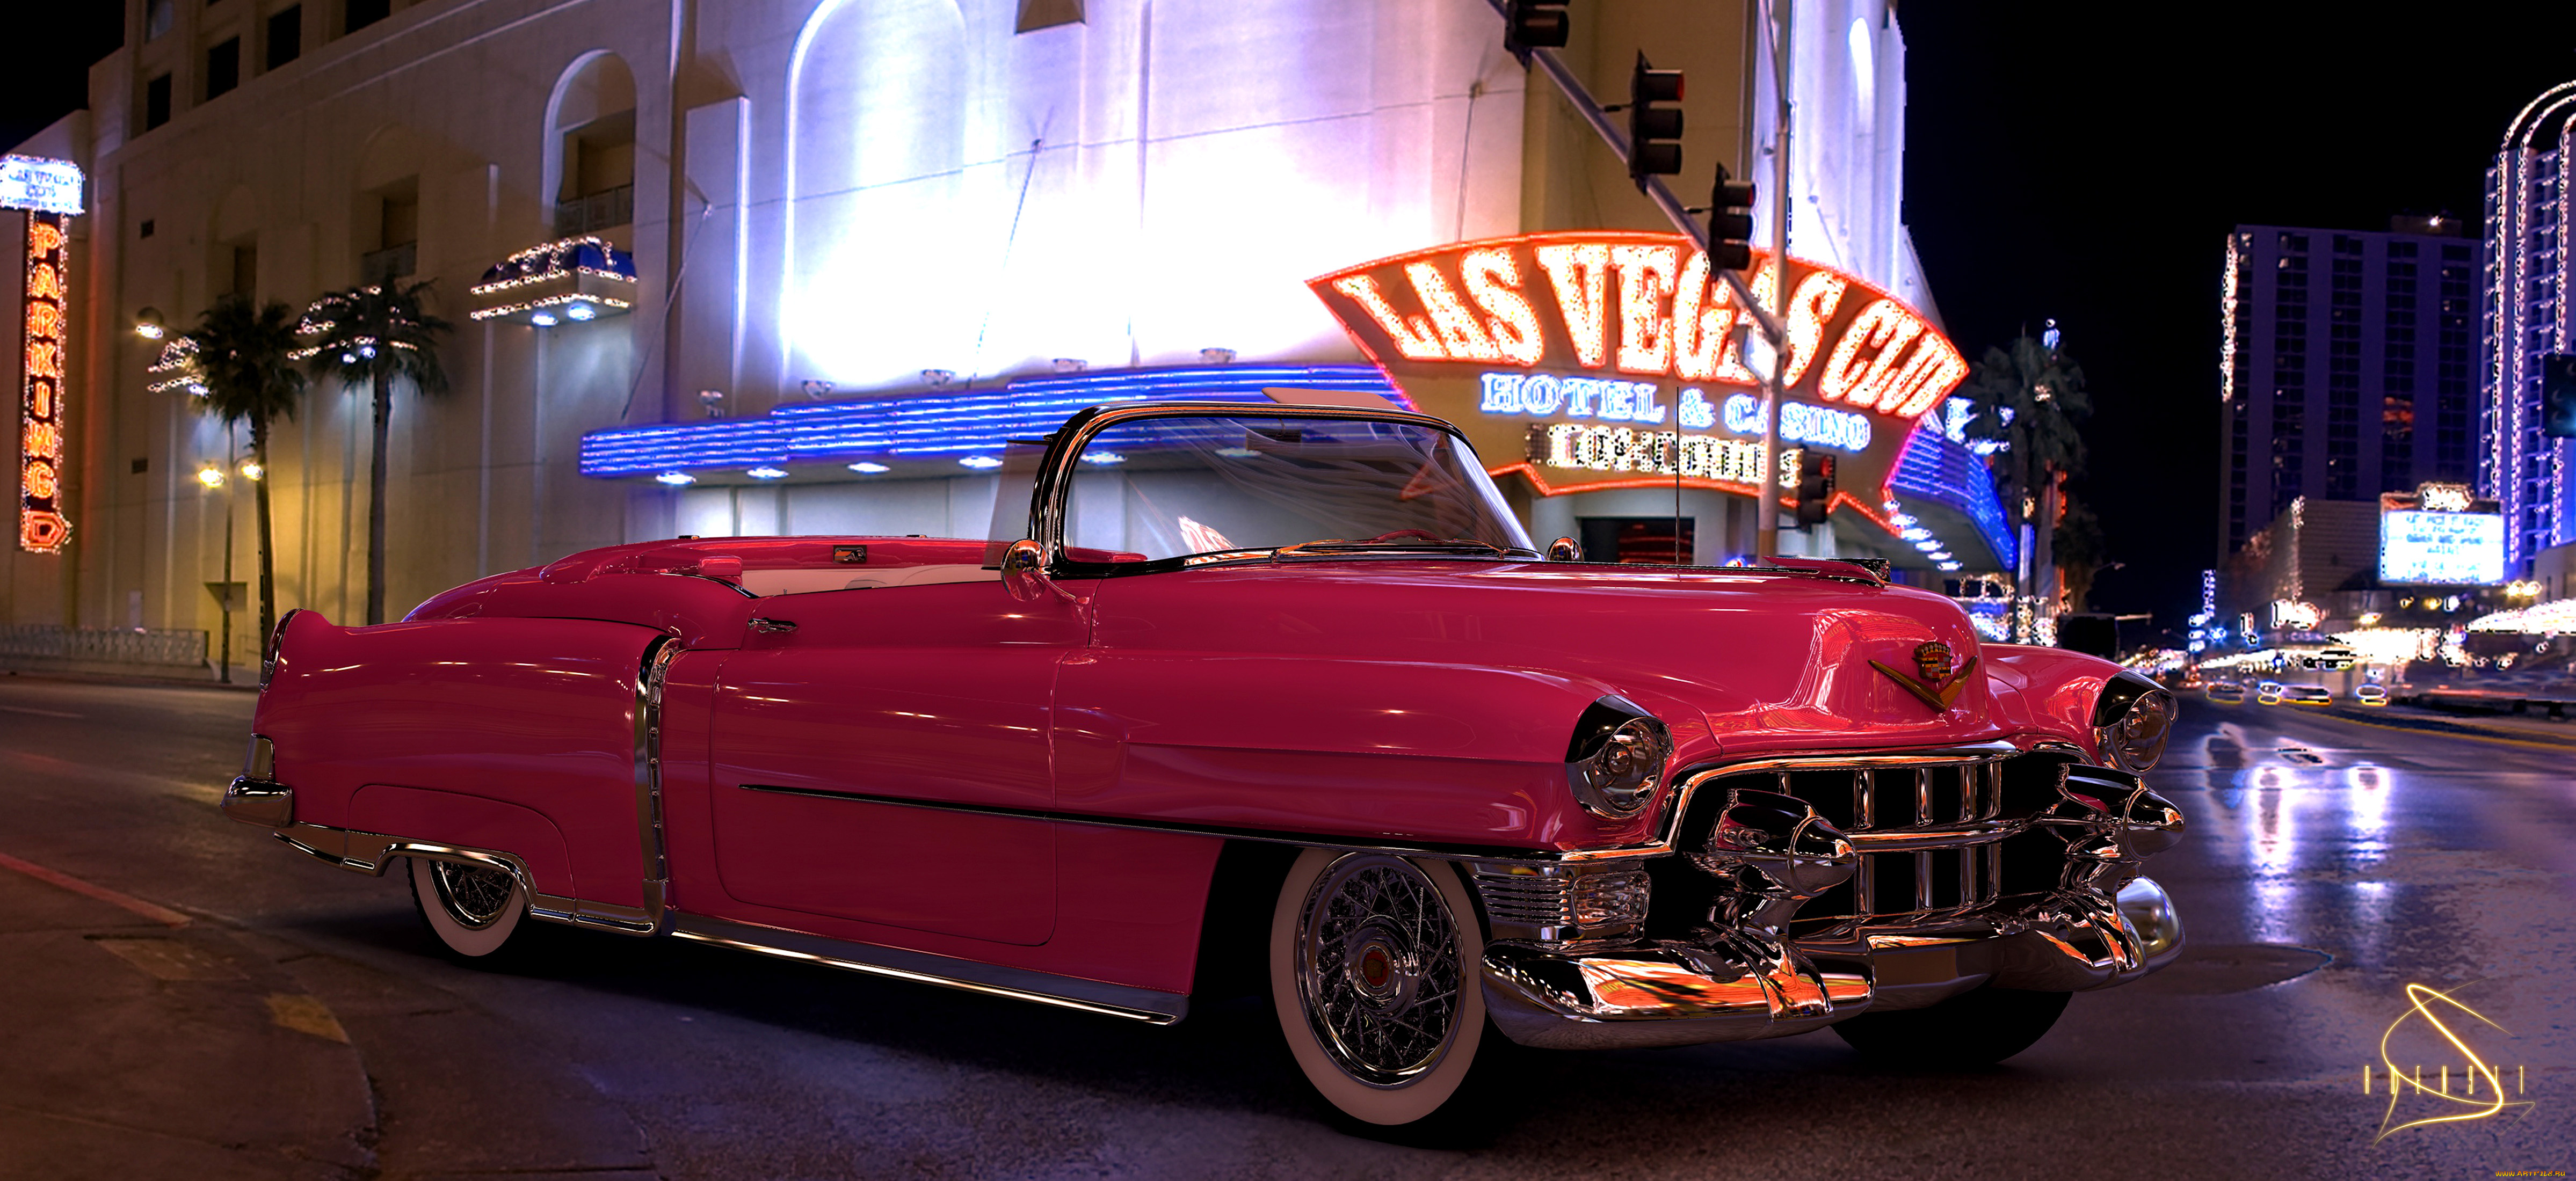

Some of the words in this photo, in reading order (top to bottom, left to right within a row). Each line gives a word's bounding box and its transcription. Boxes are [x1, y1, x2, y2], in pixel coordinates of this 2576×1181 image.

[27, 222, 60, 498] PARKING
[1332, 247, 1544, 367] LAS
[1818, 297, 1970, 419] CLUB
[1481, 373, 1665, 423] HOTEL
[1678, 388, 1716, 428] &
